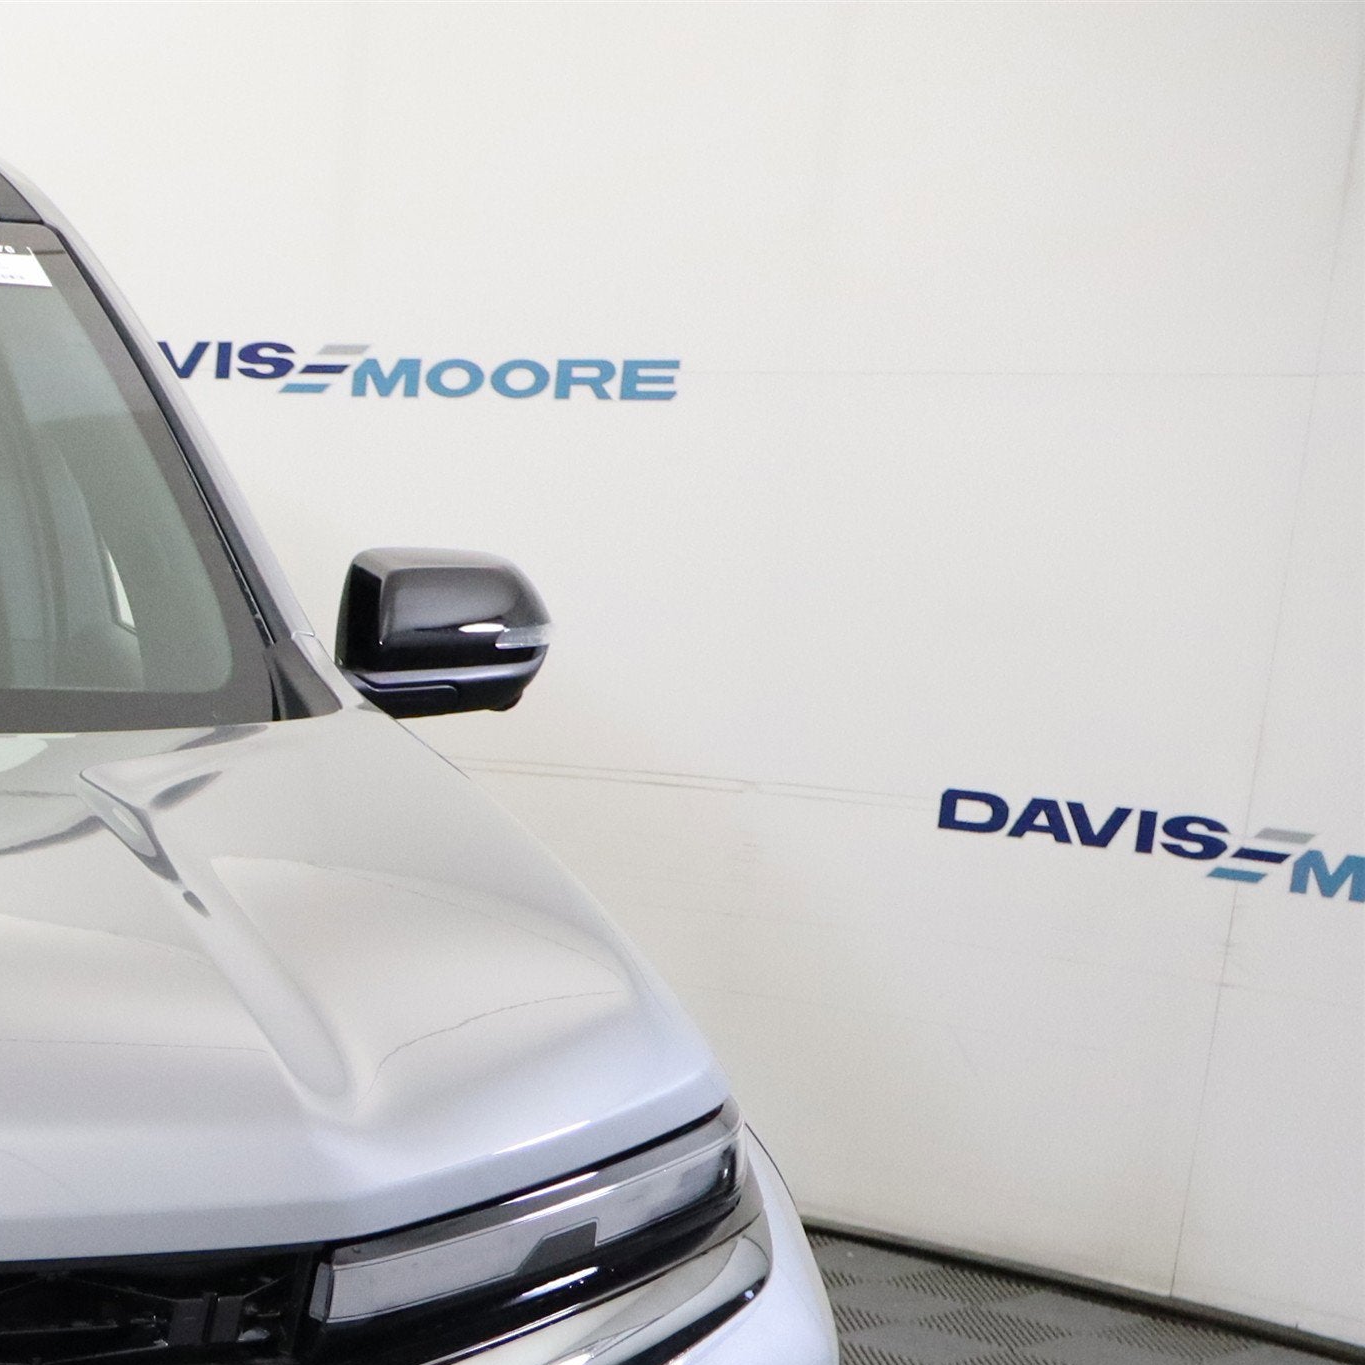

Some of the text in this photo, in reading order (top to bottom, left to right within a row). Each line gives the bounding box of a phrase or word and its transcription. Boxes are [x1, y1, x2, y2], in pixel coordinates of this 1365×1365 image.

[155, 341, 682, 401] VIS MOORE
[936, 788, 1231, 862] DAVIS
